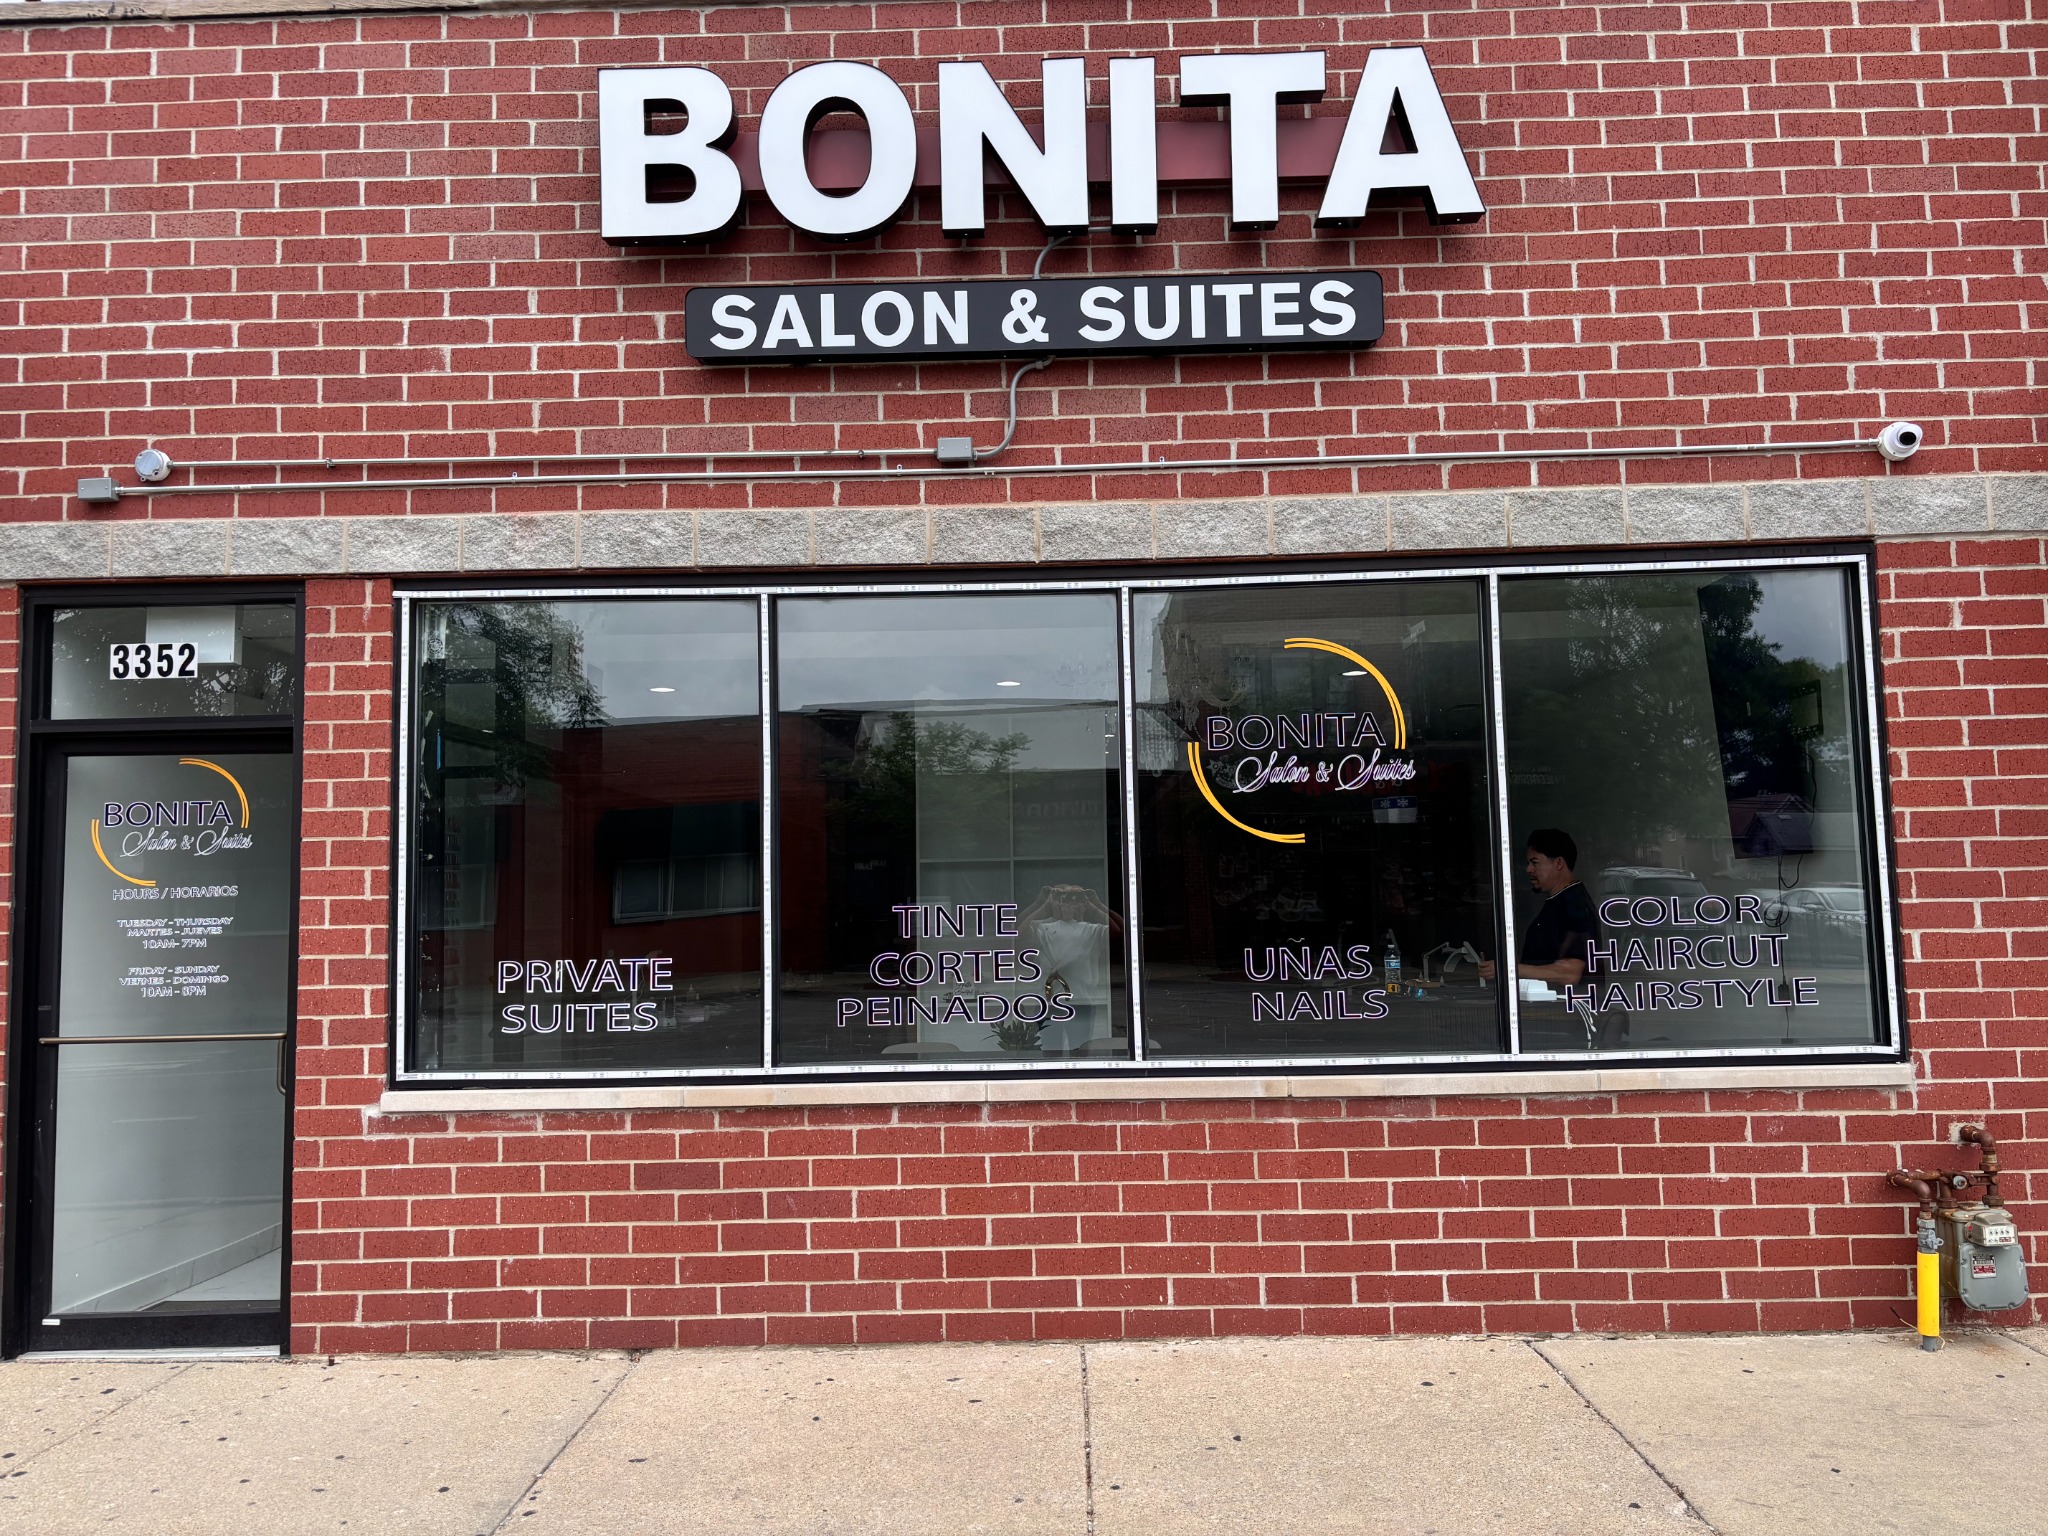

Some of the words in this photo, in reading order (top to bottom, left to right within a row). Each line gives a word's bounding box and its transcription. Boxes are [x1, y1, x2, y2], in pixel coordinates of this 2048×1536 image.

[598, 46, 1486, 244] BONITA
[709, 288, 970, 351] SALON
[1001, 288, 1050, 344] &
[1077, 279, 1357, 342] SUITES
[112, 643, 196, 679] 3352
[1206, 711, 1387, 751] BONITA
[1232, 750, 1310, 794] Salon
[1315, 760, 1334, 783] &
[1334, 747, 1417, 791] Suites
[103, 800, 234, 828] BONITA
[119, 827, 178, 858] Salon
[180, 834, 195, 850] &
[193, 825, 253, 857] Suites
[112, 888, 160, 901] HOURS
[160, 887, 169, 900] /
[170, 885, 239, 899] HORARIOS
[1598, 894, 1763, 927] COLOR
[126, 928, 174, 937] MARTES
[181, 926, 223, 936] JUEVES
[892, 903, 1019, 939] TINTE
[181, 938, 208, 948] 7PM
[1244, 937, 1373, 982] UÑAS
[1586, 933, 1789, 973] HAIRCUT
[118, 976, 165, 986] VIERNES
[172, 974, 230, 985] DOMINGO
[127, 966, 168, 976] FRIDAY
[174, 964, 221, 975] SUNDAY
[498, 957, 674, 994] PRIVATE
[869, 949, 1042, 986] CORTES
[140, 986, 173, 998] 10AM
[181, 985, 207, 997] 8PM
[1252, 989, 1389, 1022] NAILS
[1565, 977, 1819, 1013] HAIRSTYLE
[501, 1002, 659, 1034] SUITES
[837, 992, 1076, 1027] PEINADOS
